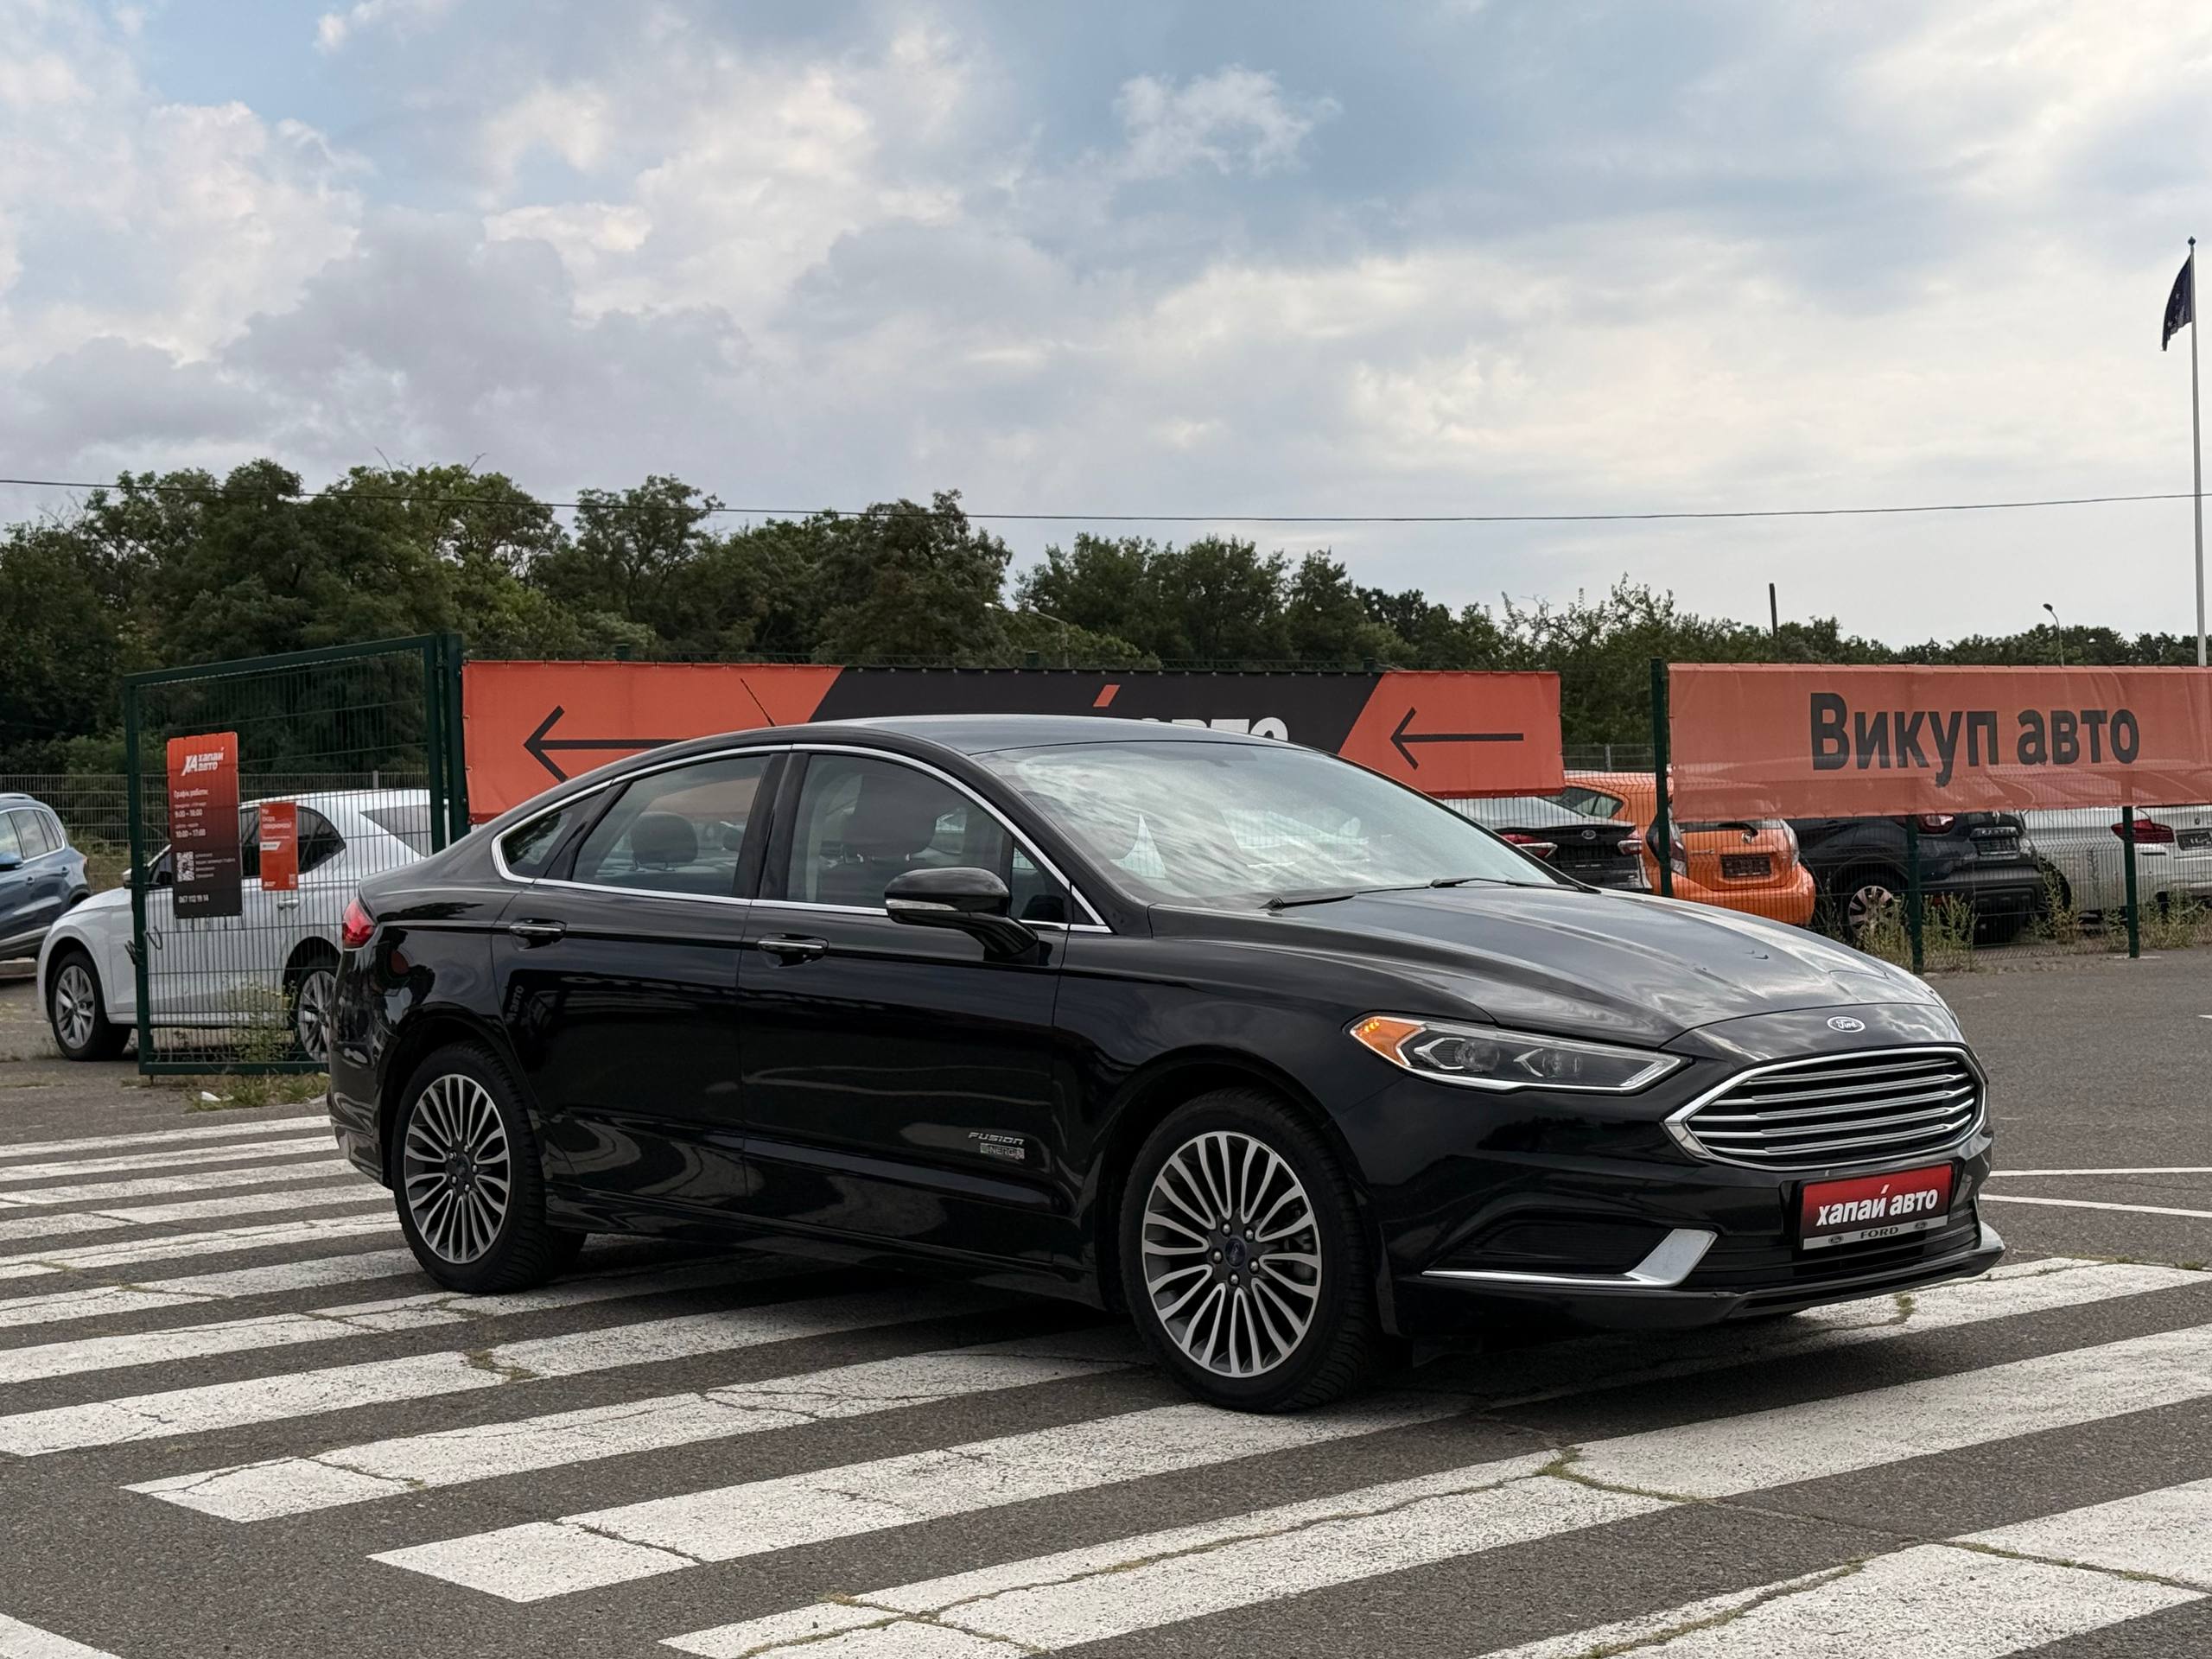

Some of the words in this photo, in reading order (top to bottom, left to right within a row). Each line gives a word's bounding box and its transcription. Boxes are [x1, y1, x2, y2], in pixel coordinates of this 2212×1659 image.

[1810, 692, 1999, 789] Викуп
[2017, 709, 2139, 766] авто
[968, 1131, 1025, 1145] FUSION
[1816, 1184, 1890, 1226] хапай
[1889, 1189, 1938, 1216] авто
[1860, 1226, 1899, 1239] FORD
